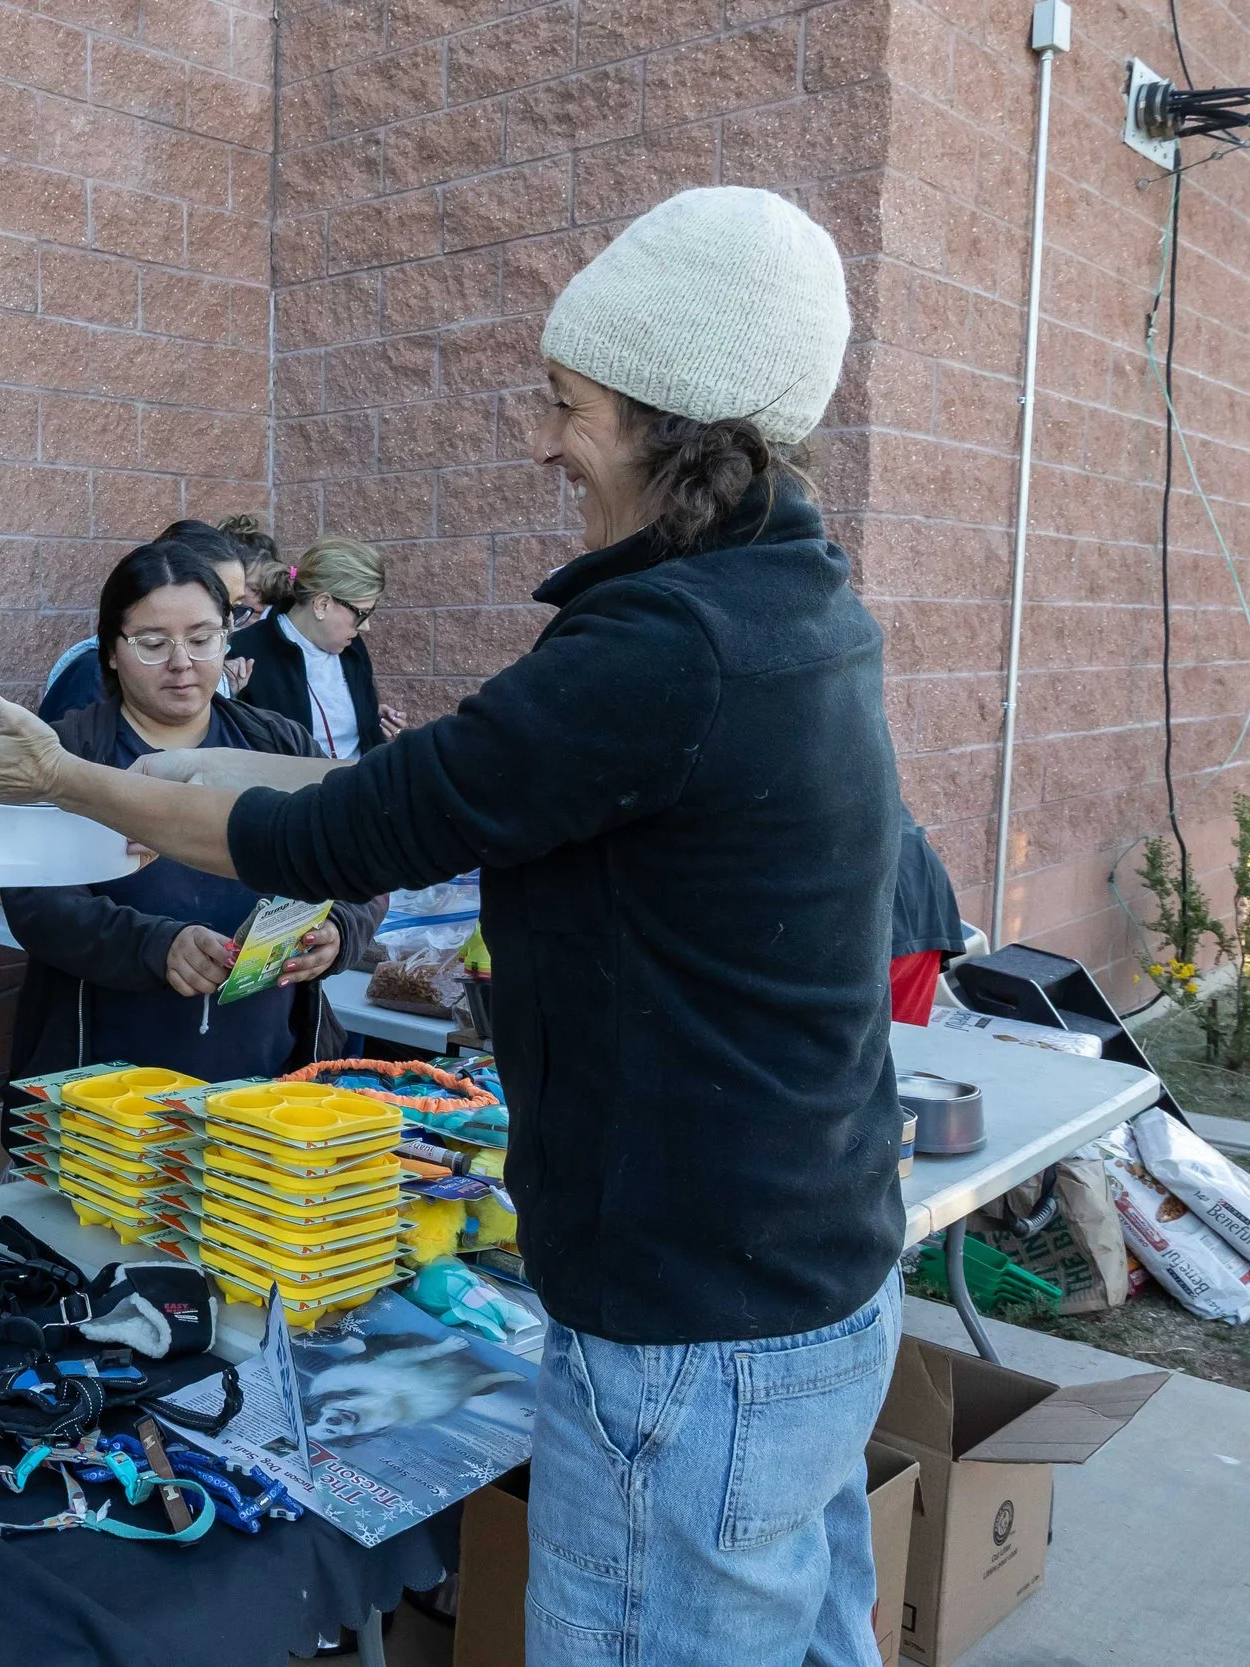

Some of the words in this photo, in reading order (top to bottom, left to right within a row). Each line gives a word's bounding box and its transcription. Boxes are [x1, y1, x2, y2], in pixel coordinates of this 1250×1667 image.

[1160, 1249, 1211, 1294] Beneful
[261, 1458, 282, 1472] Dog
[284, 1471, 315, 1493] Tucson
[320, 1473, 364, 1505] The
[326, 1460, 400, 1508] Tucson
